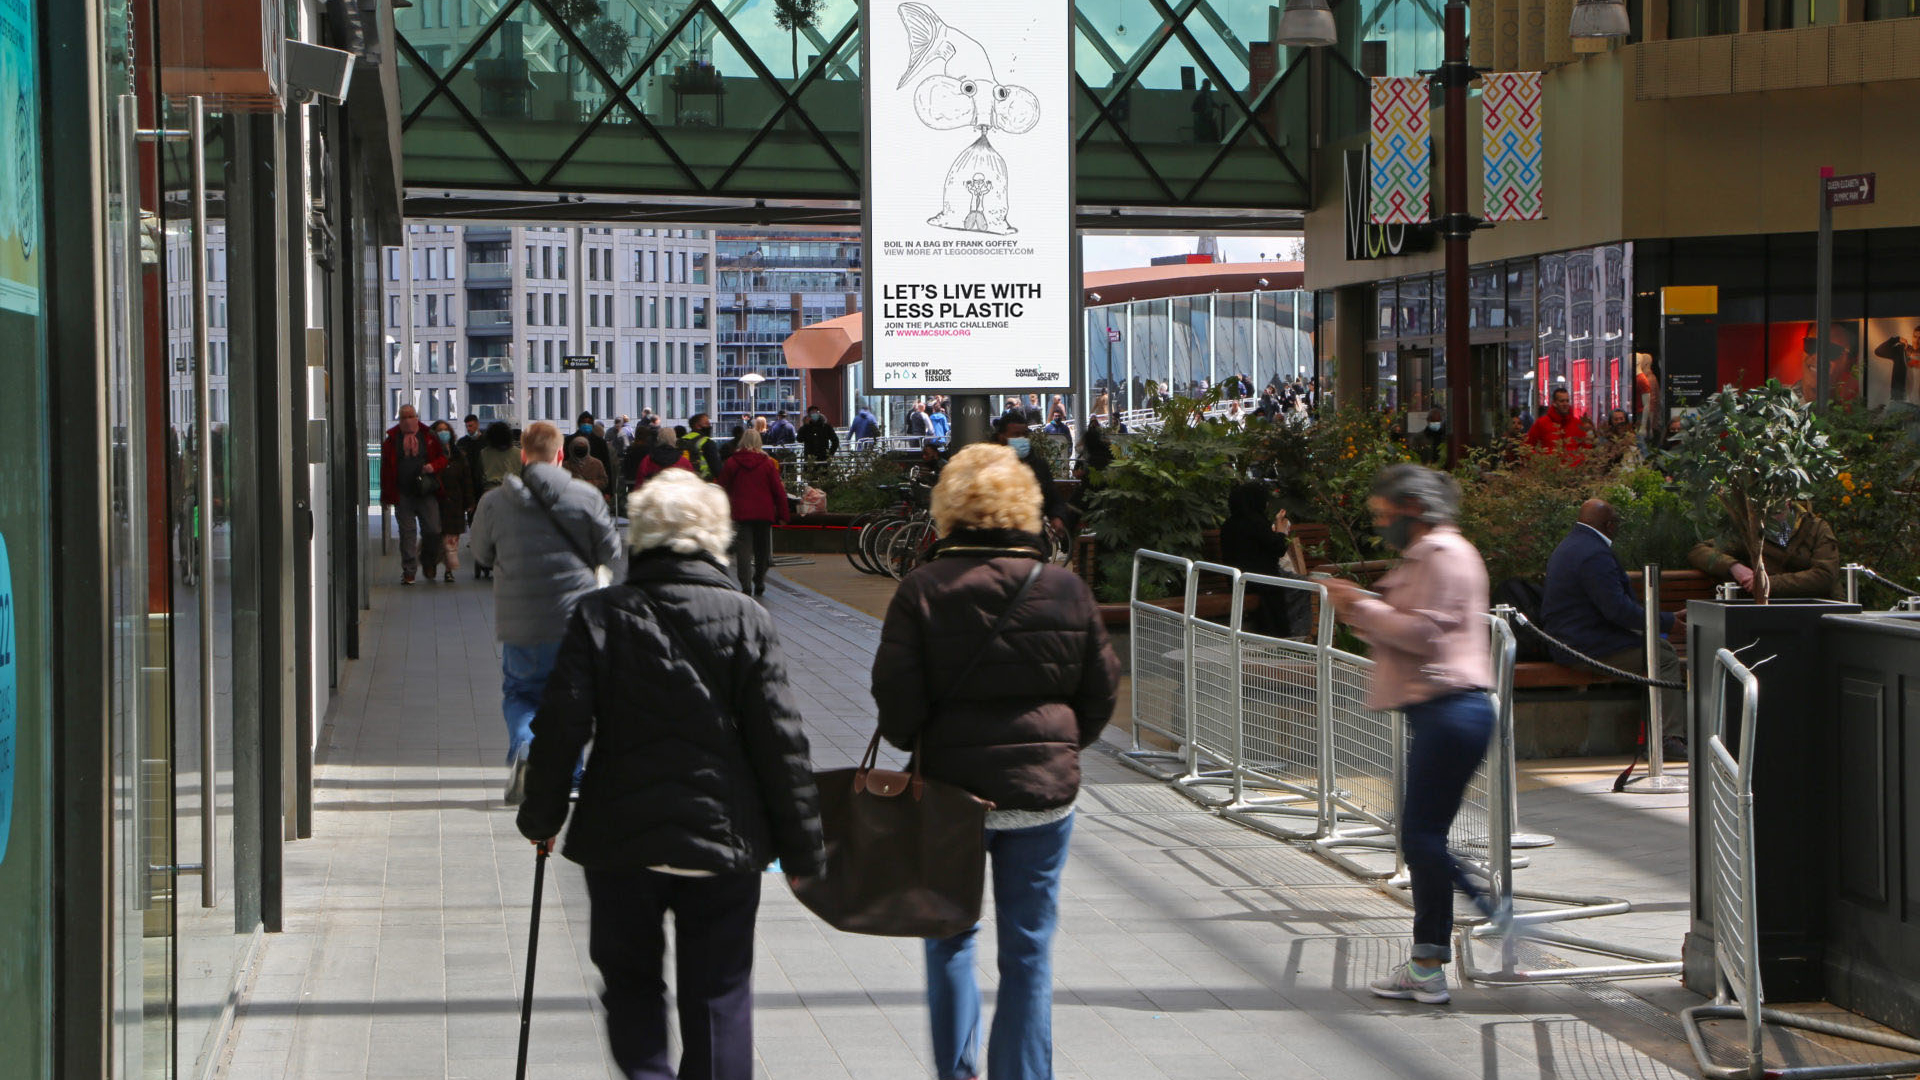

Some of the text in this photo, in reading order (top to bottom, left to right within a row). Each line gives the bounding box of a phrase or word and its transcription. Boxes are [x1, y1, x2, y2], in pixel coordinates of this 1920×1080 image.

[884, 284, 1041, 299] LET'S LIVE WITH
[884, 303, 1023, 318] LESS PLASTIC
